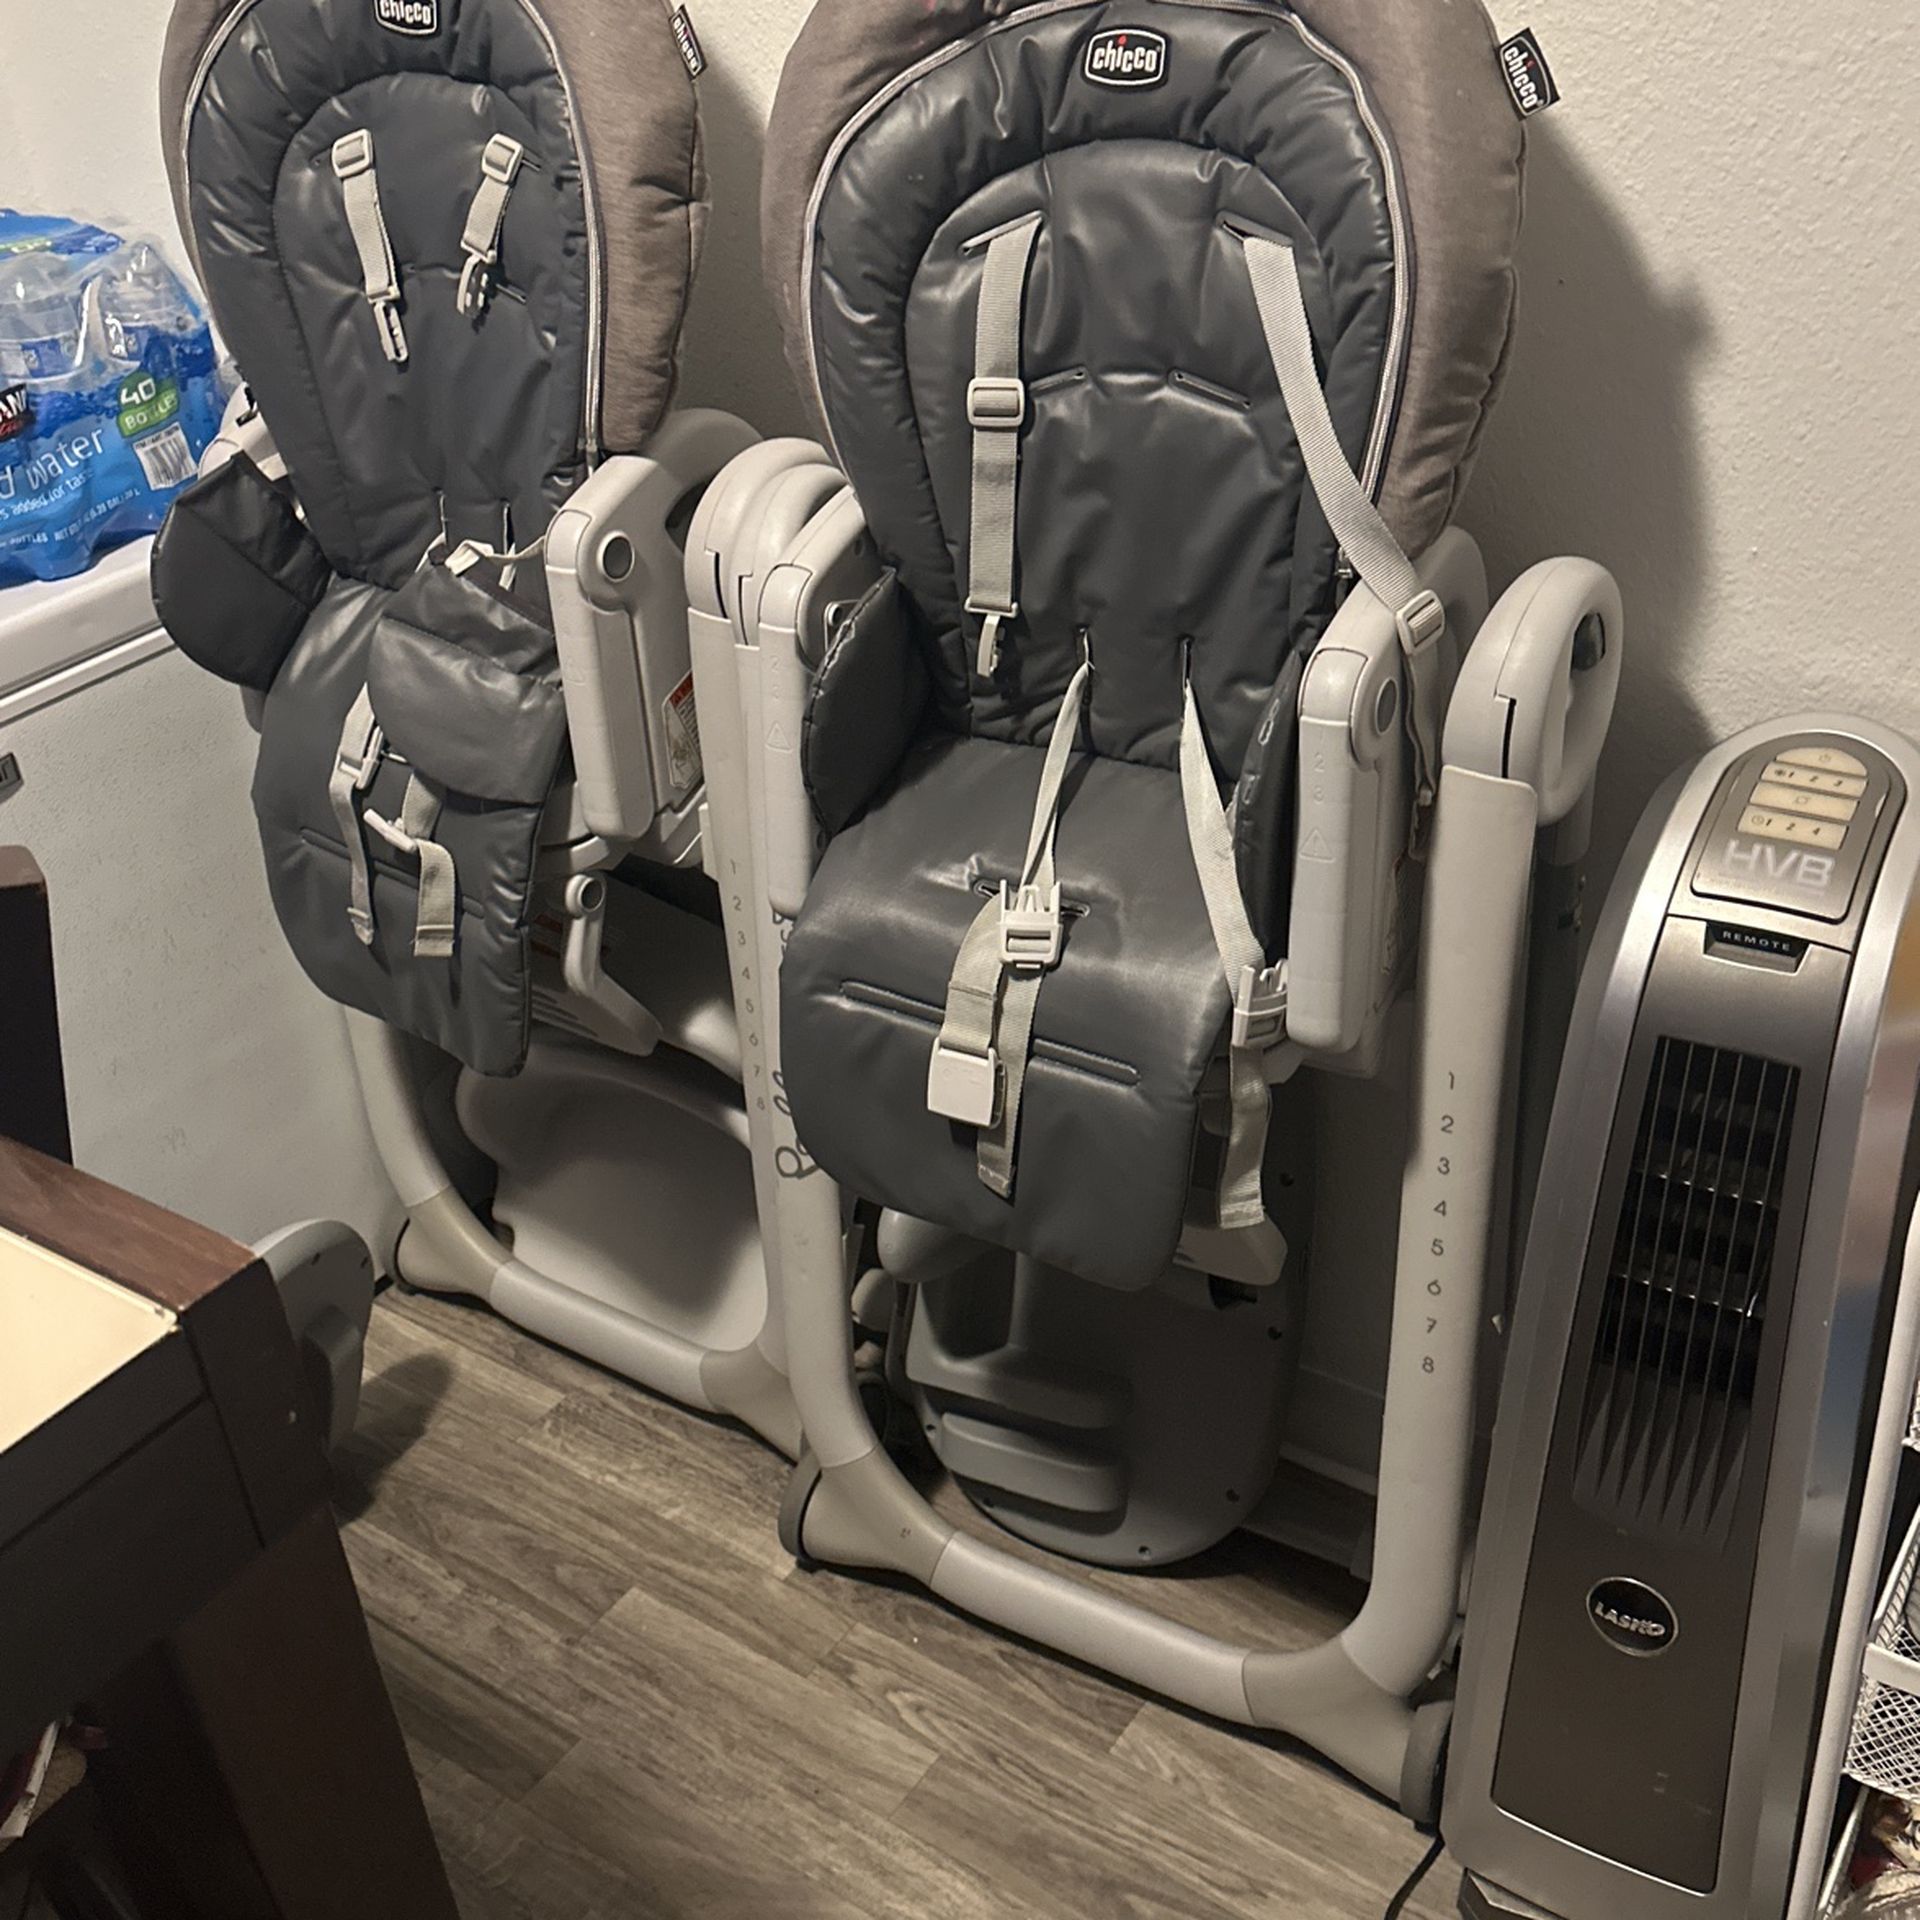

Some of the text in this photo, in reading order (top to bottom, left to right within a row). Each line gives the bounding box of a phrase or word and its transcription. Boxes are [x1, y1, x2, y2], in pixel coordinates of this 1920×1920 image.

[379, 0, 432, 25] chicco
[1092, 34, 1158, 73] chicco
[1503, 46, 1539, 109] chicco
[120, 377, 156, 405] 40
[26, 428, 104, 490] water
[1313, 751, 1325, 773] 2
[1722, 837, 1837, 889] HVB
[1722, 930, 1792, 951] REMOTE
[1448, 1071, 1456, 1091] 1
[1440, 1114, 1454, 1134] 2
[1437, 1156, 1451, 1175] 3
[1433, 1200, 1447, 1217] 4
[1430, 1238, 1445, 1257] 5
[1426, 1279, 1442, 1297] 6
[1426, 1316, 1438, 1334] 7
[1421, 1356, 1435, 1374] 8
[1594, 1601, 1666, 1637] LASKO
